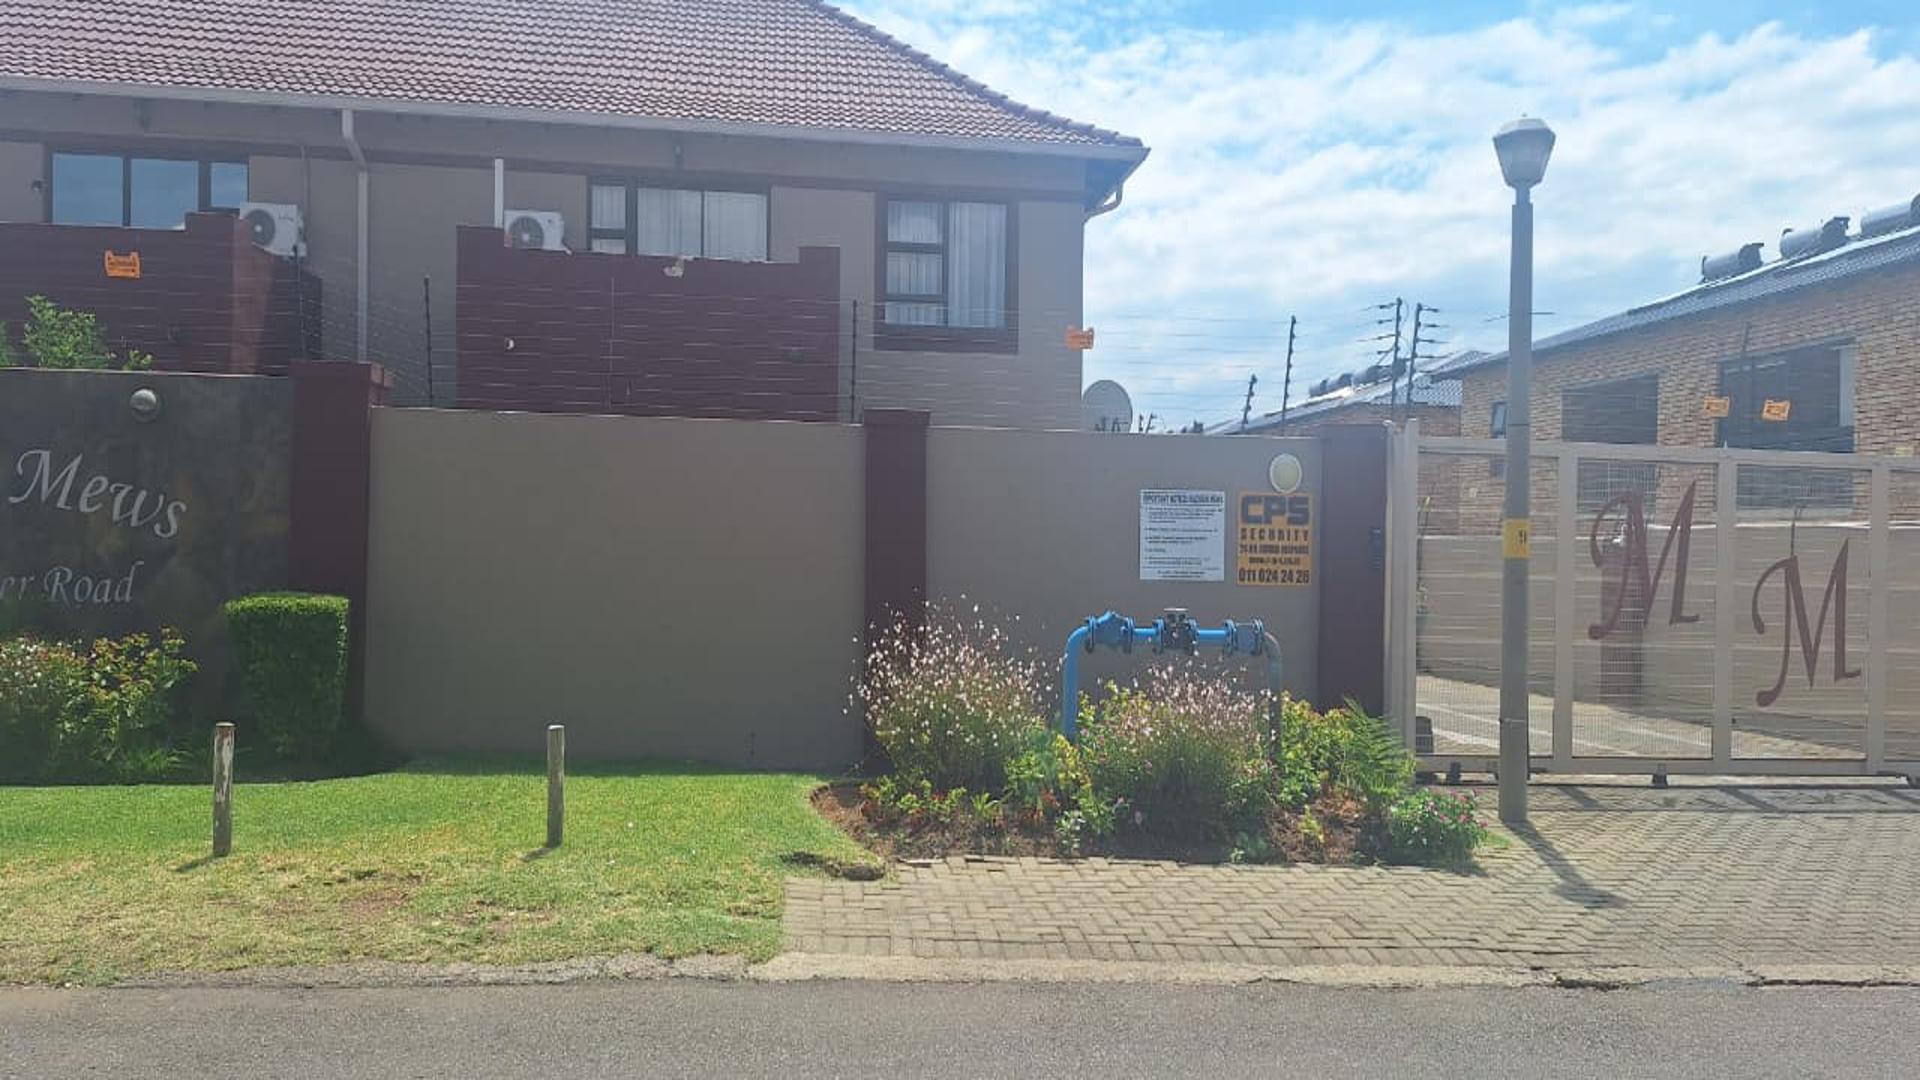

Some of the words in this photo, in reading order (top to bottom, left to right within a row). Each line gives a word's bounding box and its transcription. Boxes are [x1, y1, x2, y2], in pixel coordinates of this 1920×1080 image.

[9, 449, 187, 538] Mews
[1241, 495, 1310, 525] CPS
[1240, 527, 1309, 541] SECURITY
[44, 560, 144, 612] Road
[1239, 567, 1257, 583] 011
[1280, 568, 1294, 583] 24
[1588, 479, 1700, 640] M
[1752, 538, 1861, 707] M
